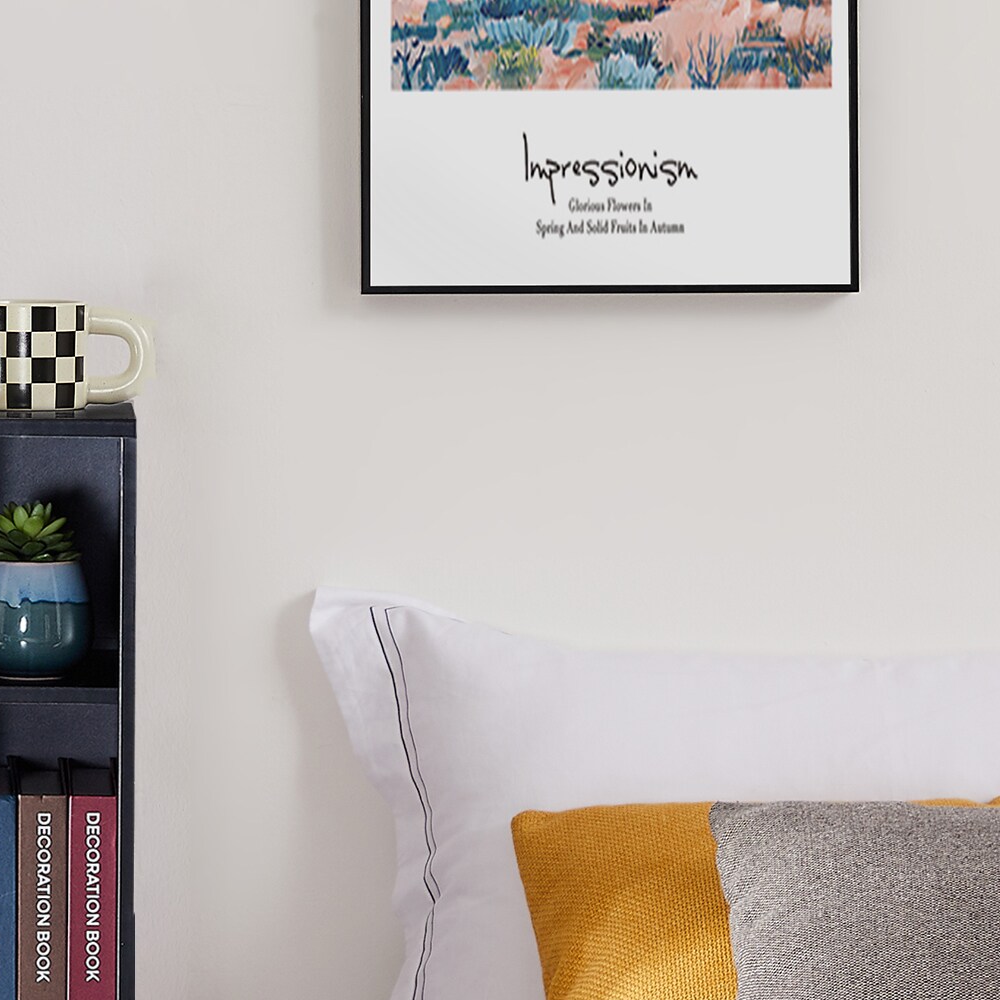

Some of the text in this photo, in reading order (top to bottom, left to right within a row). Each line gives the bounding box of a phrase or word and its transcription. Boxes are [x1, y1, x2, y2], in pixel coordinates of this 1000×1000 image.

[523, 132, 698, 205] Impressionism
[568, 197, 653, 212] Glorious Flowers In
[536, 219, 685, 239] Spring And Solid Fruits In Autumn
[36, 812, 52, 983] DECORATION BOOK
[85, 812, 101, 983] DECORATION BOOK
